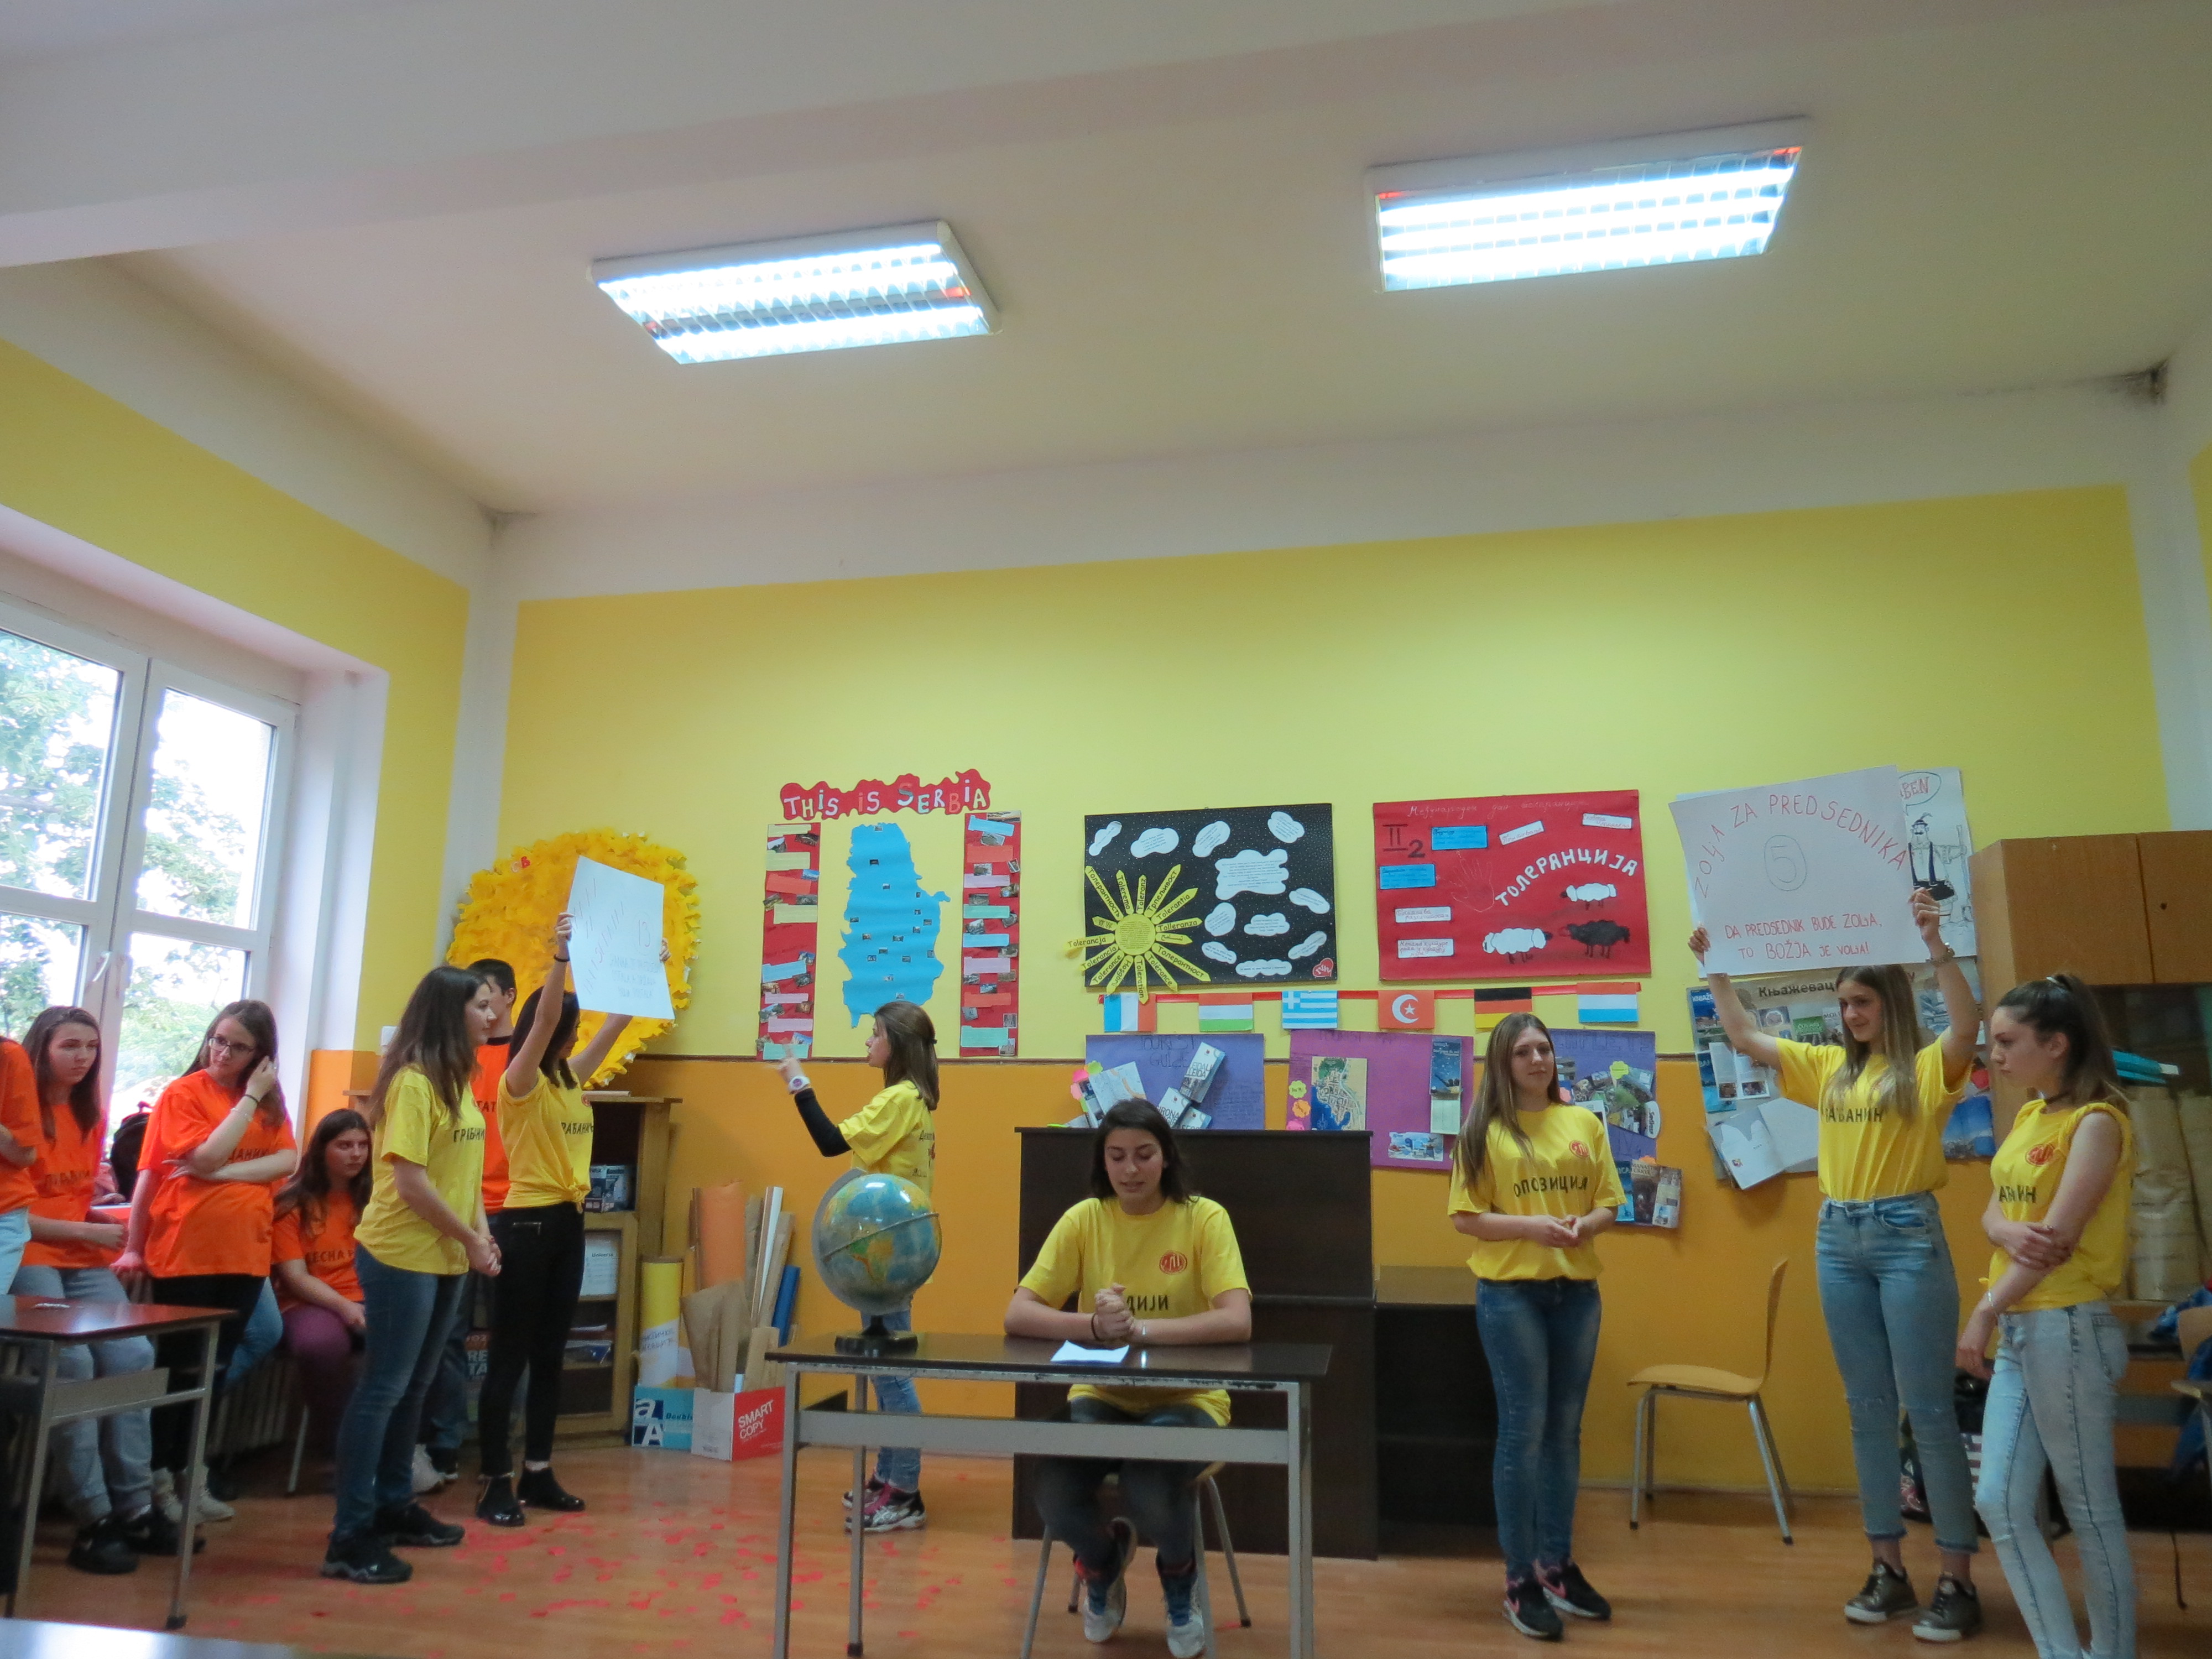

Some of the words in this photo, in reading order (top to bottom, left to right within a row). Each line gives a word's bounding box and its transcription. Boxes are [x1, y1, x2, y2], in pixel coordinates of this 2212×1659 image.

[1900, 776, 1929, 799] BEN
[1730, 802, 1758, 828] ZA
[1770, 794, 1907, 871] PREDSEDNIKA
[1494, 848, 1638, 906] ТОЛЕРАНЦИЈА
[1771, 844, 1797, 884] 5
[1136, 878, 1146, 911] Toleranz
[1156, 894, 1191, 920] Tolerantia
[1157, 920, 1198, 931] Tolleranza
[1725, 925, 1741, 939] DA
[1746, 919, 1805, 937] PREDSEDNIK
[1811, 915, 1837, 931] BUDE
[1068, 936, 1107, 948] Tolerancja
[1738, 947, 1754, 959] TO
[1081, 946, 1117, 969] Tolerancia
[1092, 954, 1122, 983] Tolerance
[1147, 954, 1173, 987] Tolérance
[1157, 946, 1204, 978] Толерантност
[1136, 959, 1144, 999] Toleration
[1159, 1106, 1180, 1118] IRONA
[738, 1399, 774, 1429] SMART
[739, 1418, 765, 1440] COPY
